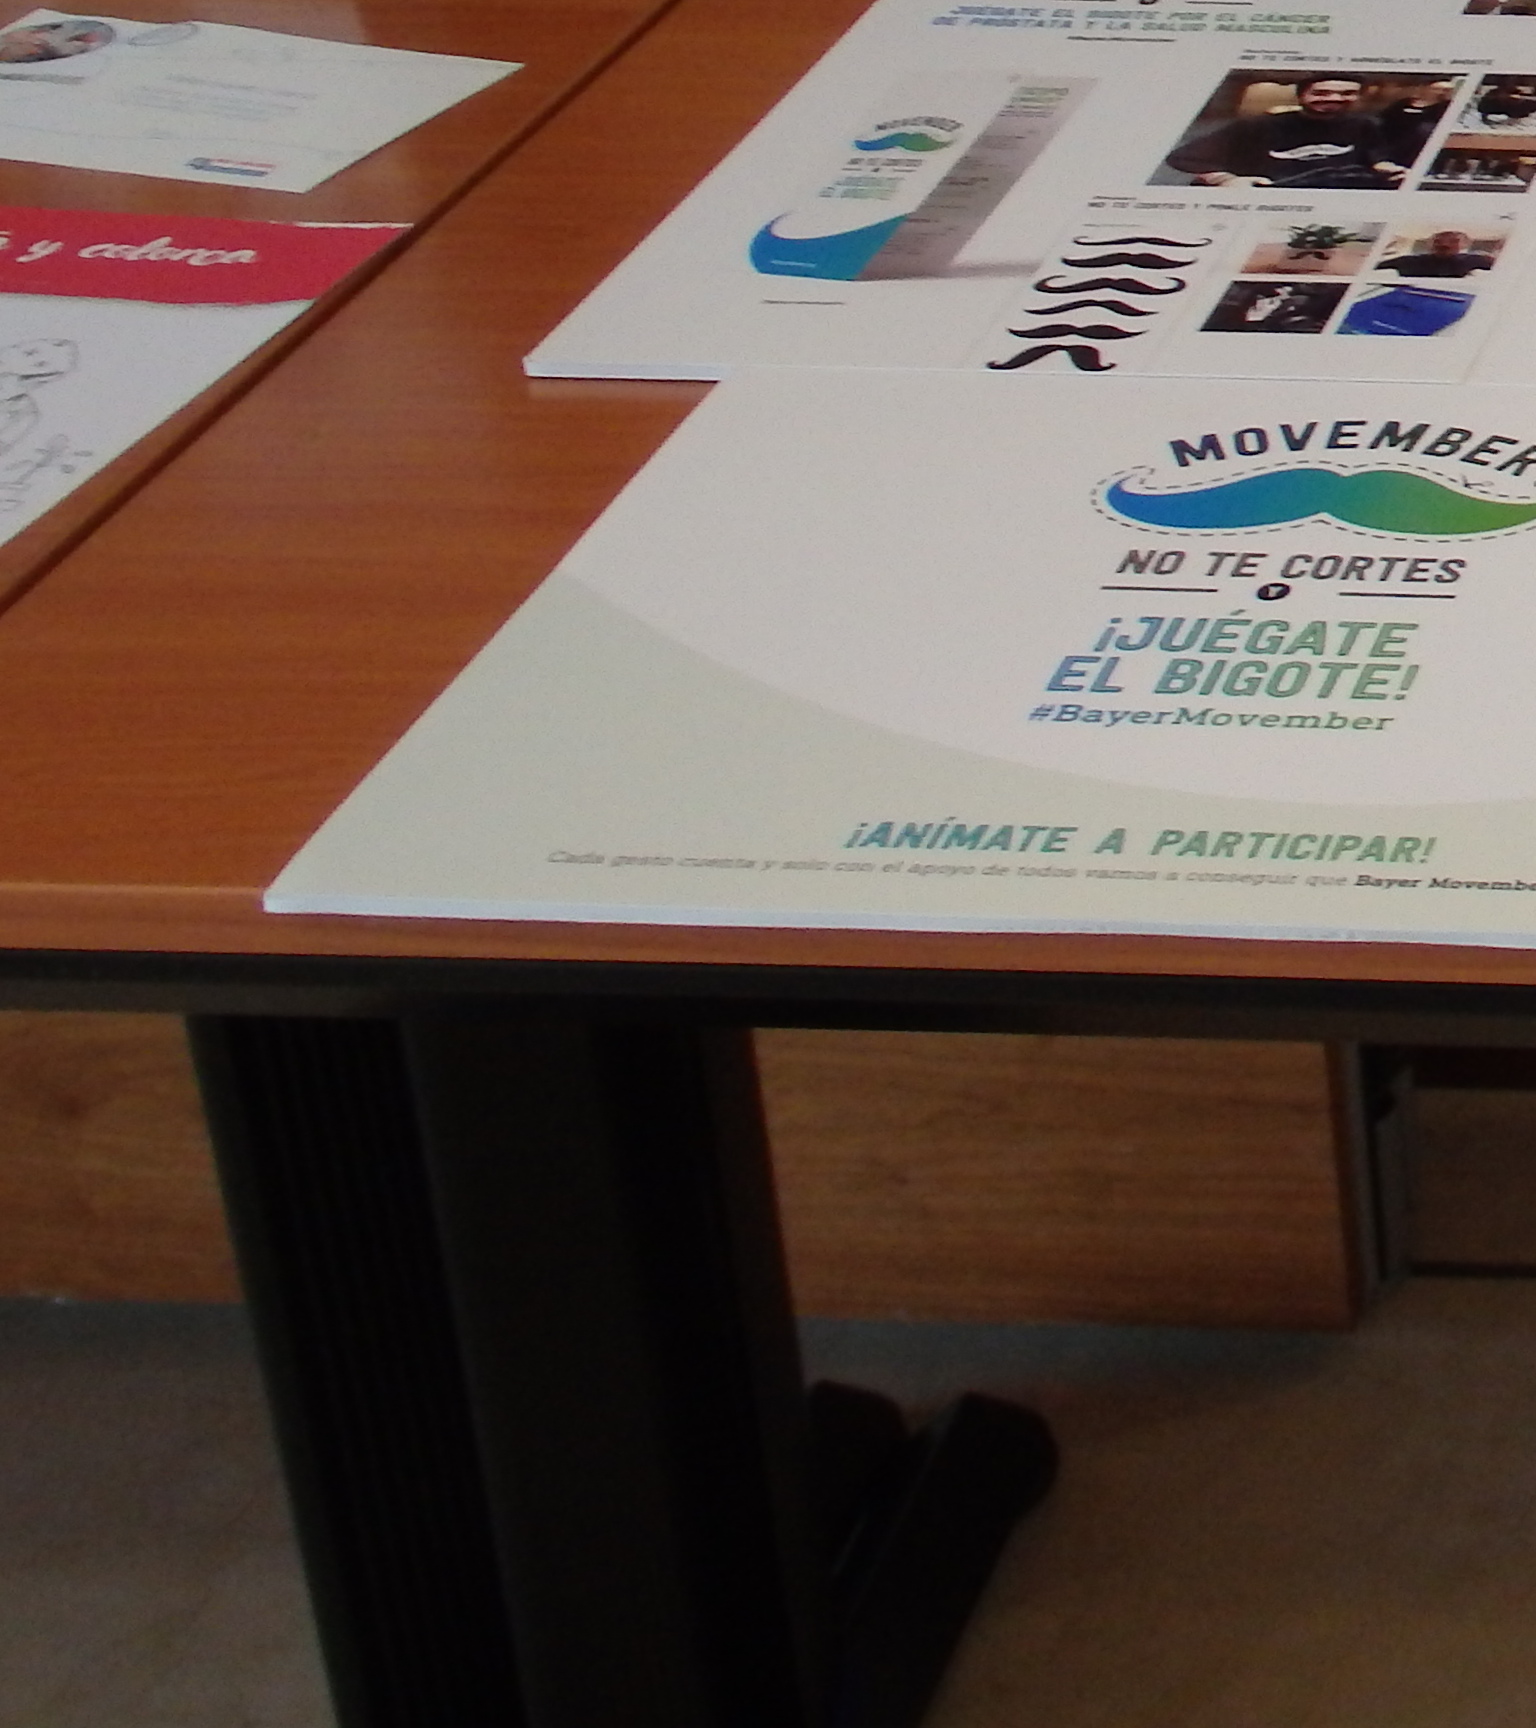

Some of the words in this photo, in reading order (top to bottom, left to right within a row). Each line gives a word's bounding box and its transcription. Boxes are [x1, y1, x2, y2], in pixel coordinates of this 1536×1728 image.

[1115, 548, 1187, 576] NO
[1208, 551, 1267, 579] TE
[1280, 552, 1468, 584] CORTES
[1092, 610, 1420, 659] ¡JUÉGATE
[1046, 655, 1123, 694] EL
[1154, 657, 1421, 702] BIGOTE!
[1027, 704, 1396, 733] #BayerMovember
[844, 817, 1079, 854] ¡ANÍMATE
[1093, 827, 1127, 855] A
[1150, 828, 1438, 865] PARTICIPAR!
[1353, 873, 1422, 892] Bayer
